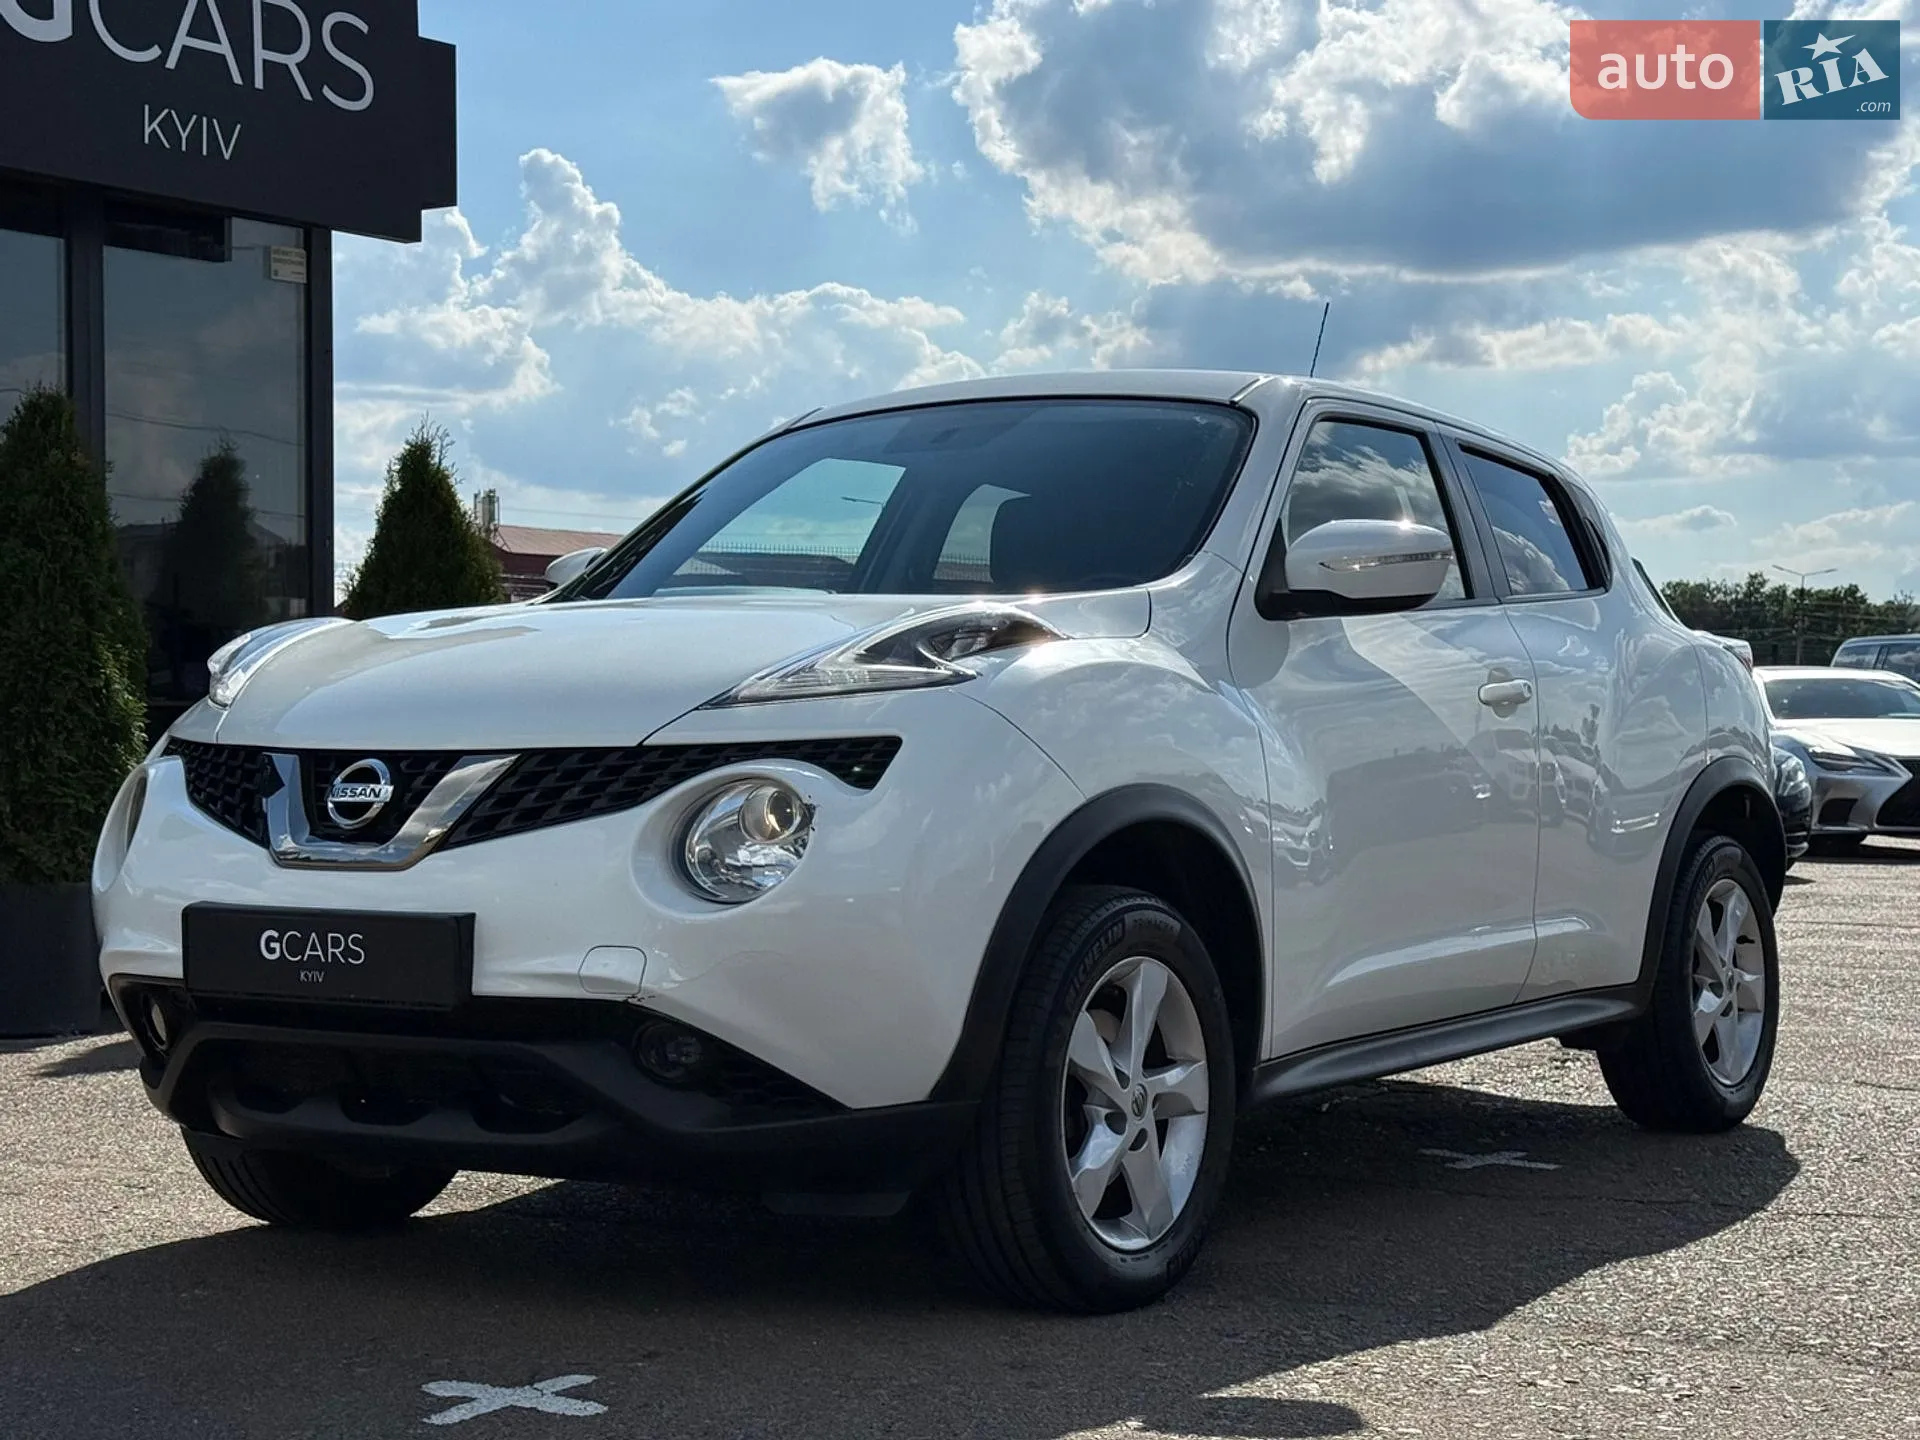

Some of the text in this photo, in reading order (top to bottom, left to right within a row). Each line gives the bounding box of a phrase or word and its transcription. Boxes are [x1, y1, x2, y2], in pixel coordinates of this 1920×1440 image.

[144, 104, 241, 160] KYIV
[331, 787, 382, 798] NISSAN
[260, 929, 365, 965] GCARS
[300, 970, 325, 983] KYIV
